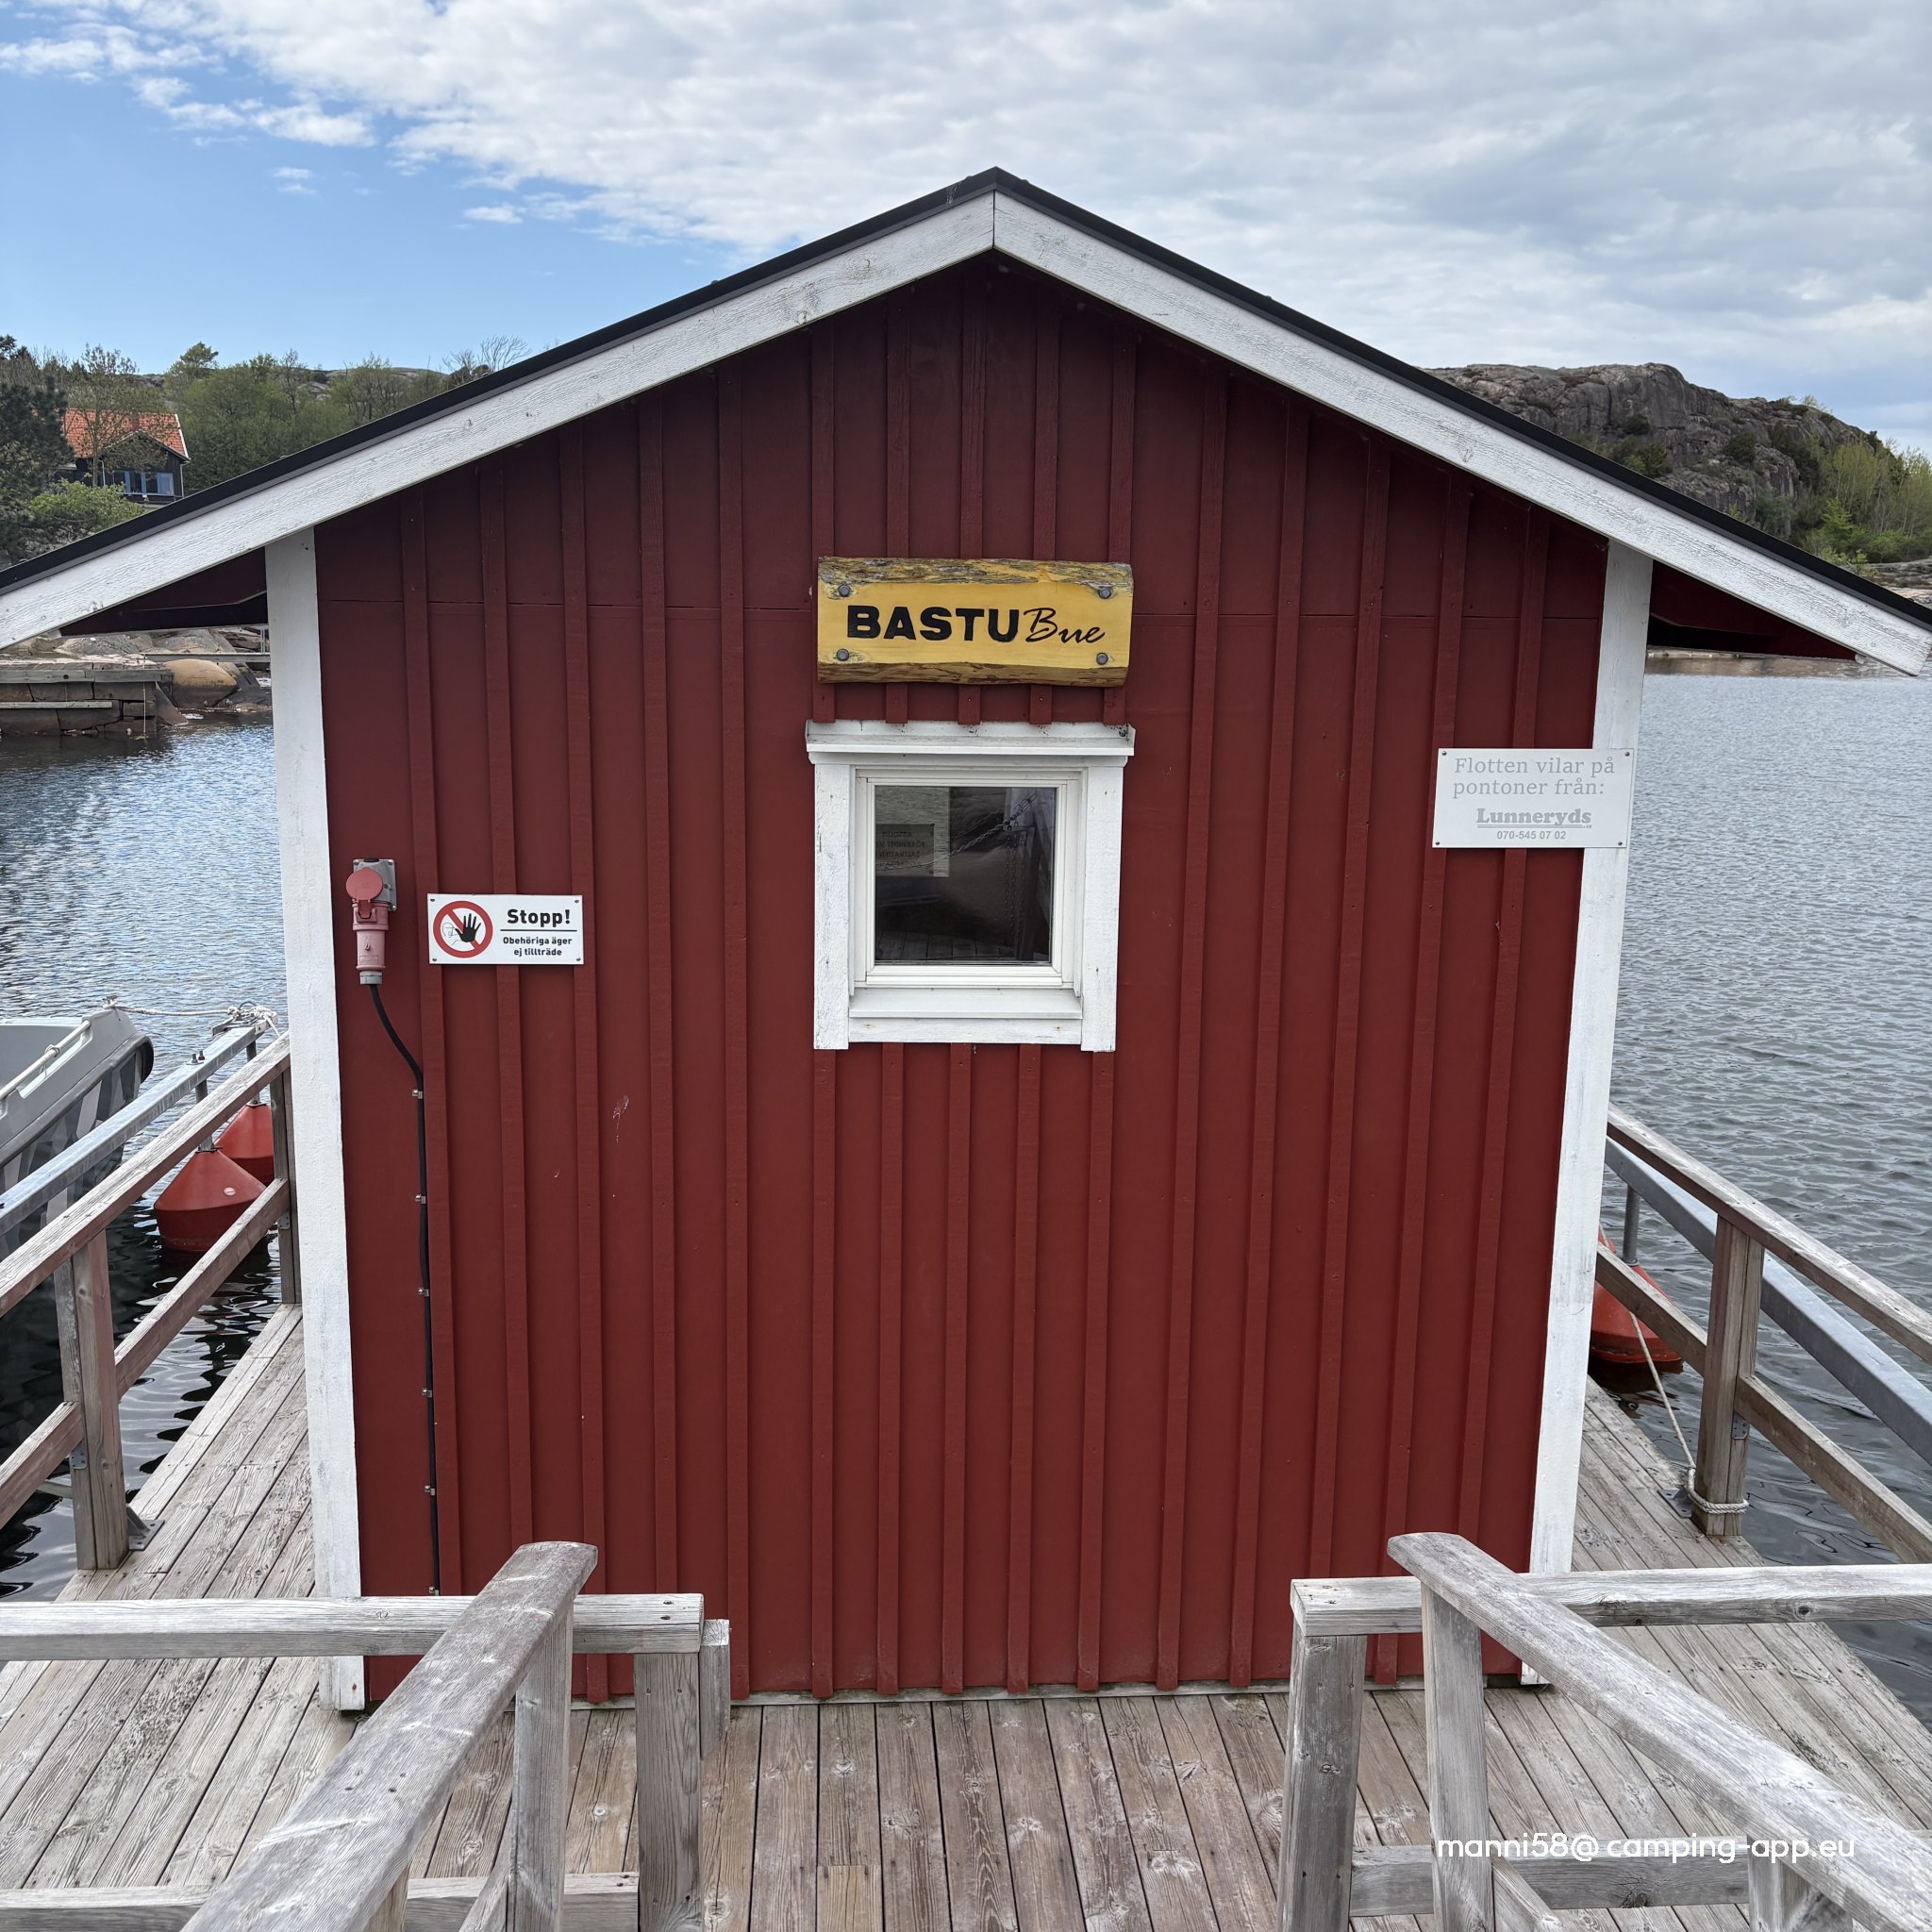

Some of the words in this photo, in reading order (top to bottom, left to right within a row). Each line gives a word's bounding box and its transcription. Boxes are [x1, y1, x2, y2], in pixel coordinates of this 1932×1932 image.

[847, 605, 1020, 642] BASTU
[1455, 758, 1528, 774] Flotten
[1536, 758, 1585, 774] vilar
[1591, 757, 1615, 777] på
[1453, 779, 1548, 799] pontoner
[1555, 777, 1605, 795] från:
[1475, 808, 1592, 825] Lunneryds
[1496, 830, 1537, 840] 070-545
[1540, 830, 1552, 840] 07
[1555, 830, 1567, 840] 02
[508, 909, 571, 927] Stopp!
[503, 937, 550, 945] Obehöriga
[551, 937, 573, 945] äger
[513, 948, 523, 958] ej
[525, 948, 562, 957] tillträde
